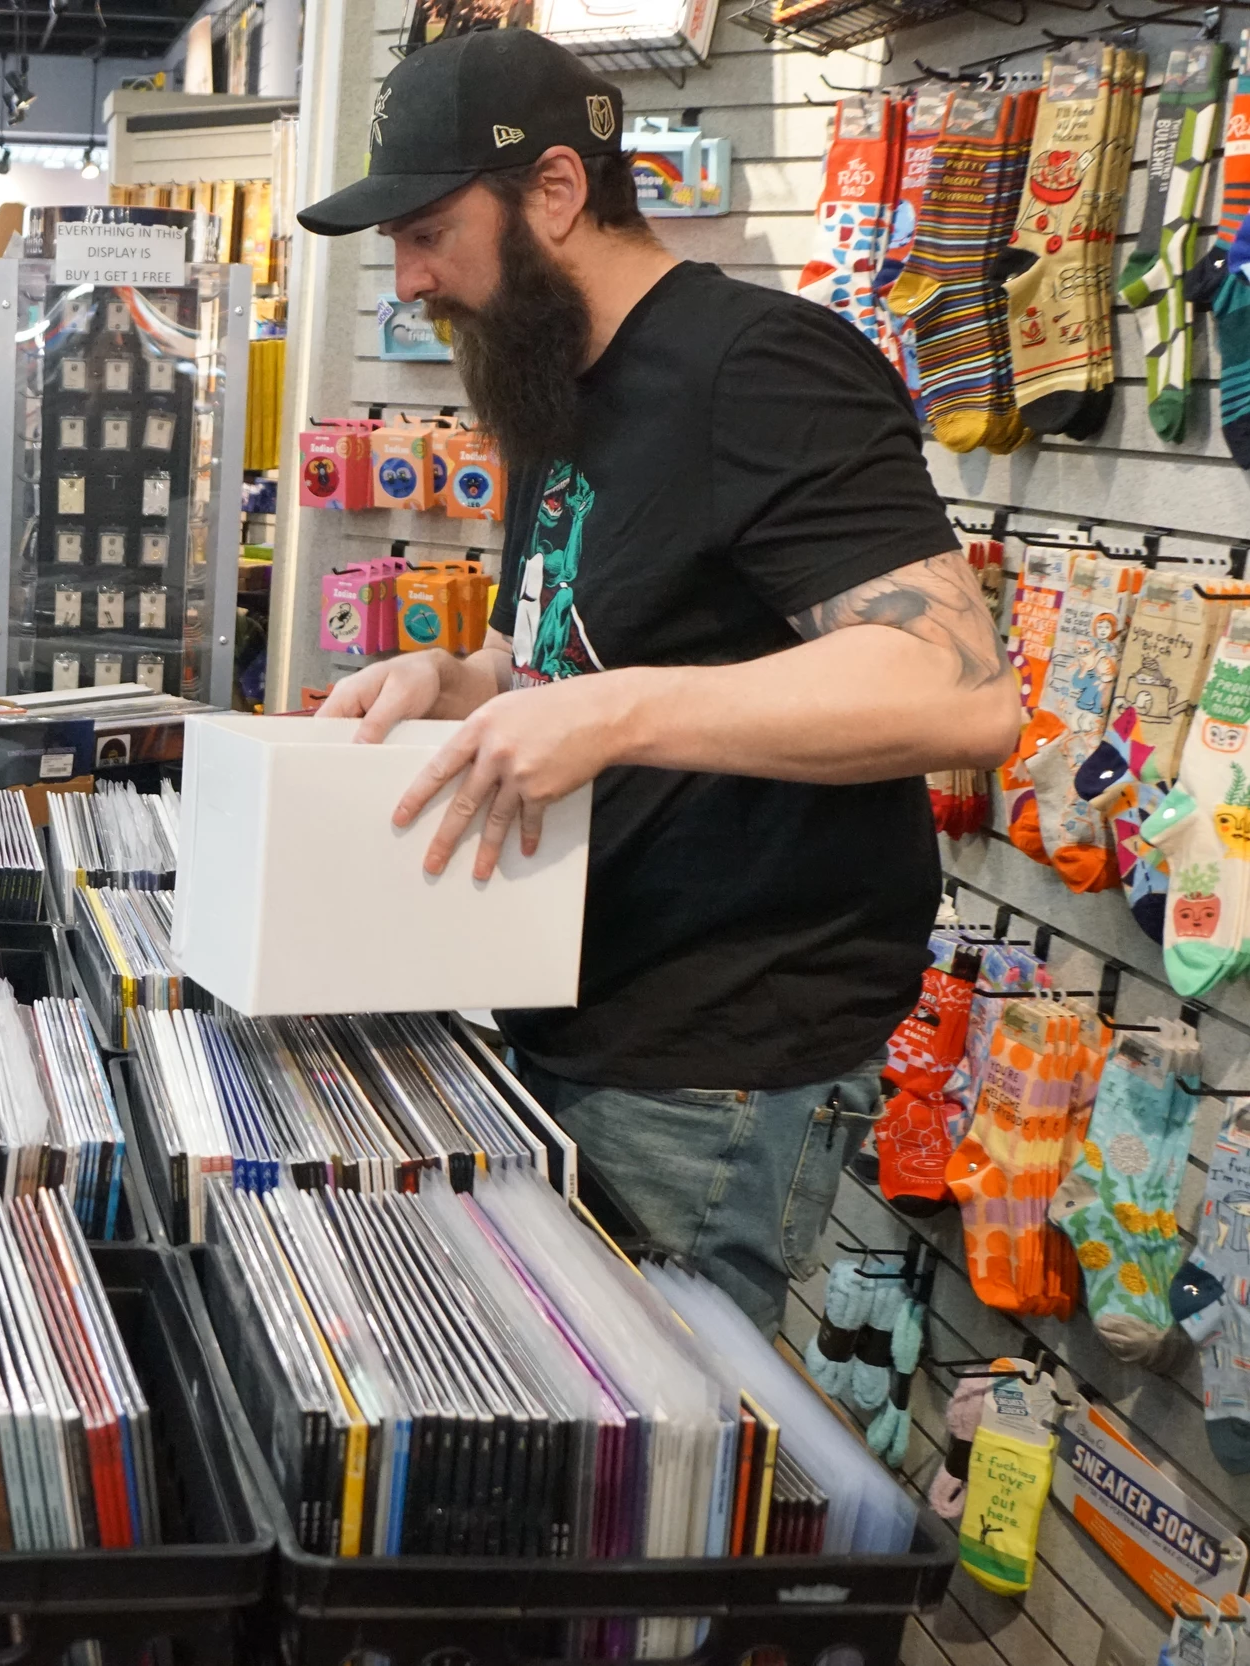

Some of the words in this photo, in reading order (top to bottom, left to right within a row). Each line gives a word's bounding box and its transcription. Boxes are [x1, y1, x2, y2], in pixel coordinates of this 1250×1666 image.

[946, 159, 987, 171] PRETTY
[1160, 141, 1176, 180] MEETING
[837, 170, 875, 185] RAD
[841, 185, 866, 197] DAD
[930, 190, 985, 203] BOYFRIEND
[58, 225, 135, 238] EVERYTHING
[139, 228, 151, 238] IN
[157, 228, 183, 240] THIS
[87, 247, 138, 259] DISPLAY
[141, 248, 151, 259] IS
[65, 270, 90, 281] BUY
[94, 271, 100, 281] 1
[104, 271, 129, 282] GET
[133, 271, 138, 282] 1
[142, 272, 171, 283] FREE
[310, 443, 335, 454] Zodiac
[384, 443, 409, 454] Zodiac
[459, 450, 488, 461] Zodiac
[333, 588, 357, 600] Zodiac
[408, 590, 434, 601] Zodiac
[1132, 626, 1153, 642] you
[1156, 633, 1193, 659] crafty
[1142, 639, 1171, 655] bitch
[917, 1023, 937, 1036] LAST
[987, 1072, 1021, 1098] FUCKING
[1229, 1157, 1250, 1174] fuc
[1000, 1406, 1026, 1416] SOCKS
[975, 1451, 984, 1463] I
[989, 1455, 1037, 1485] fucking
[988, 1467, 1025, 1490] LOVE
[1000, 1484, 1012, 1497] it
[991, 1494, 1016, 1512] out
[1072, 1444, 1152, 1522] SNEAKER
[1153, 1506, 1216, 1569] SOCKS
